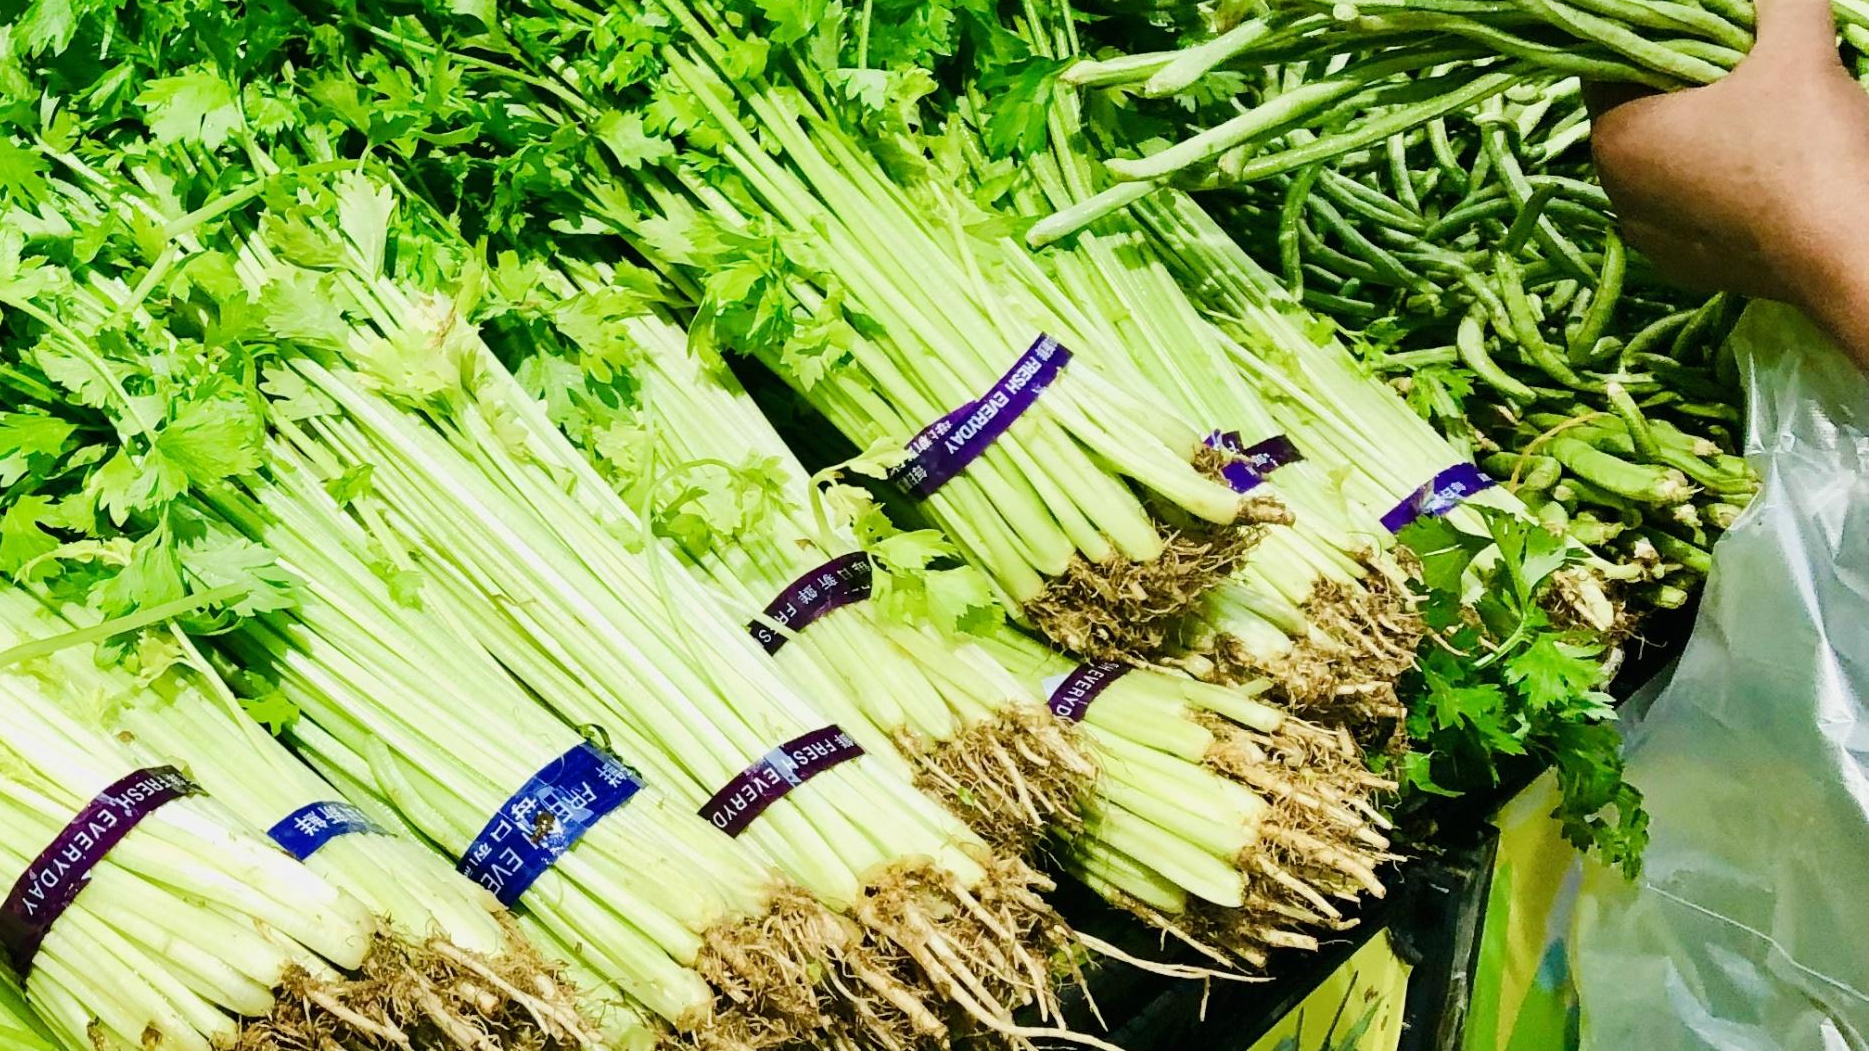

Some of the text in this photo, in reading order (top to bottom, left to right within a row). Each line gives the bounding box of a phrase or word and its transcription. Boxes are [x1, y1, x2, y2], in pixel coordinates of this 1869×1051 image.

[943, 355, 1041, 454] FRESH EVERYDAY
[781, 738, 836, 772] FRESH
[712, 766, 780, 828] EVERYD
[22, 777, 172, 916] FRESH EVERYDAY
[478, 845, 523, 895] EVE
